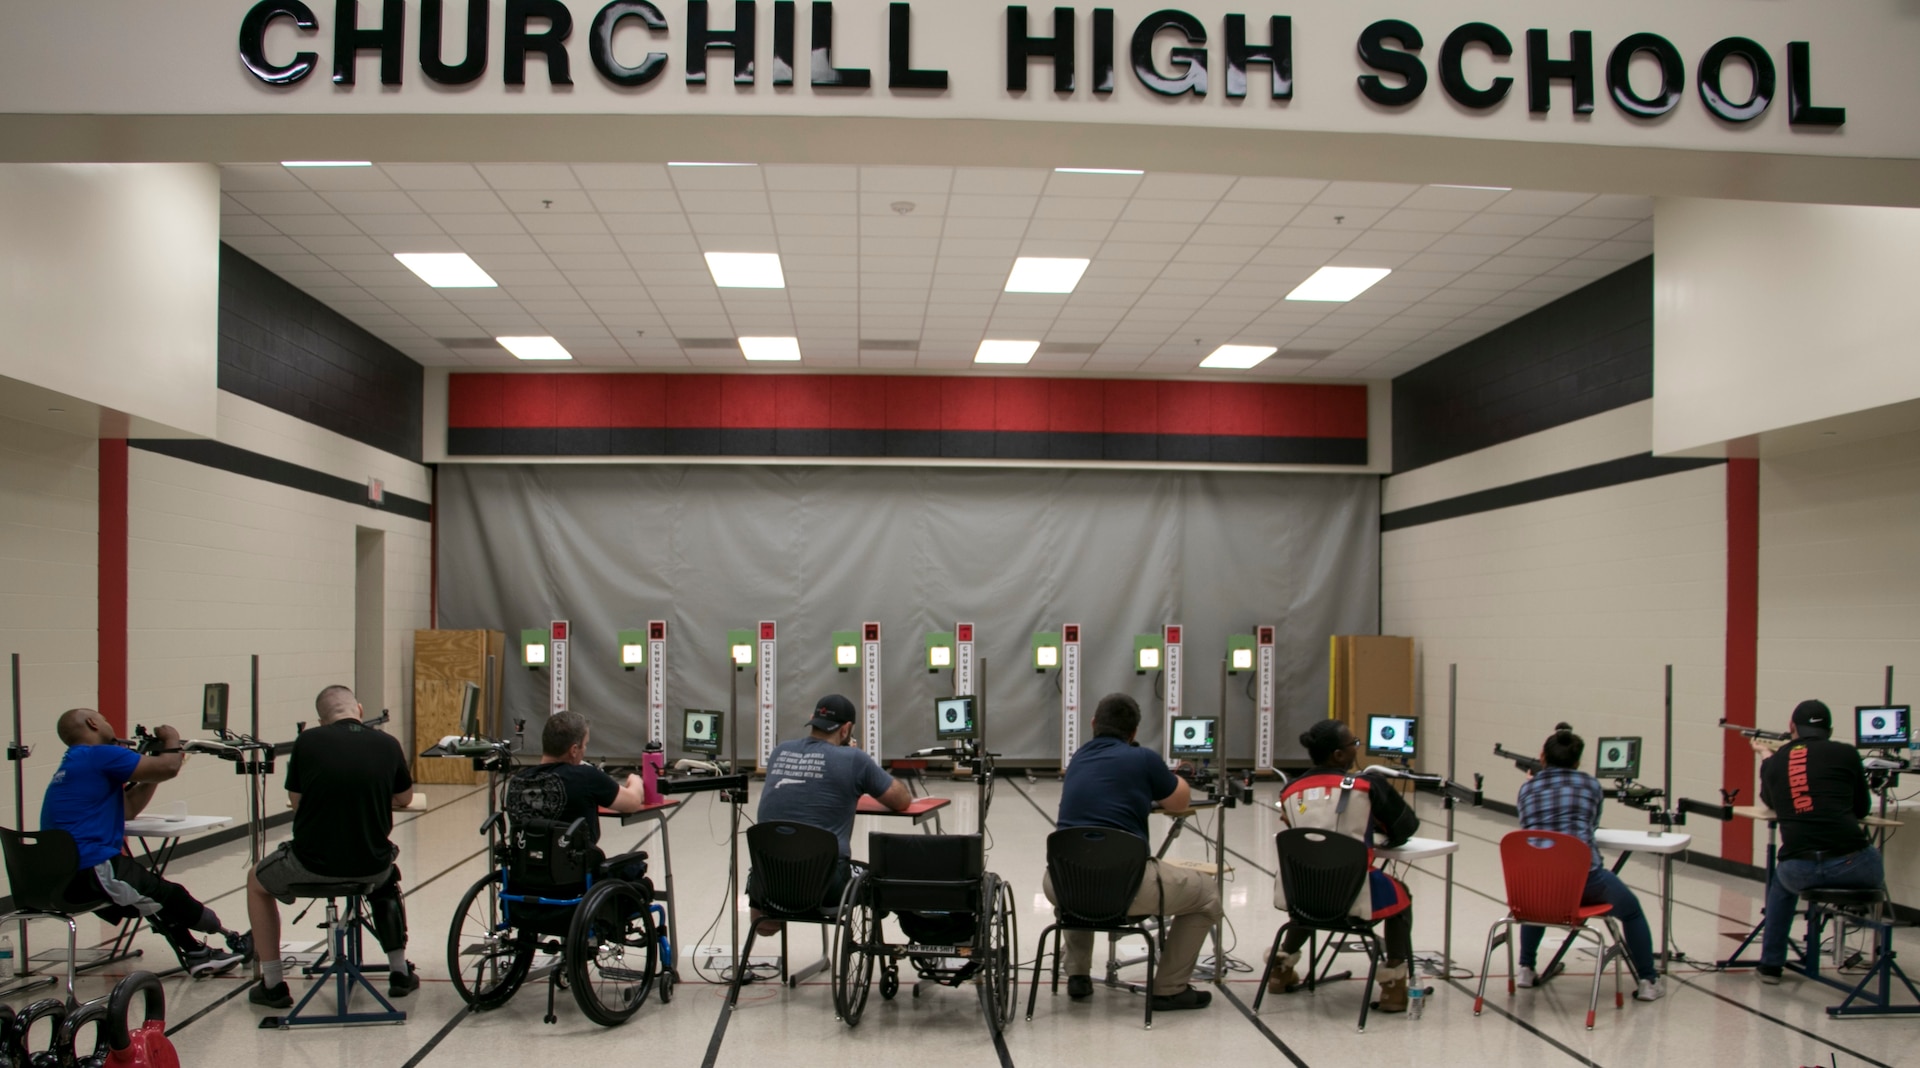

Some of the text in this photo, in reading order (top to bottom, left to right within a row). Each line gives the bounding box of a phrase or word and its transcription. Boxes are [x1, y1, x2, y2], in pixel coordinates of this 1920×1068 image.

[238, 0, 1846, 126] CHURCHILL HIGH SCHOOL
[1789, 748, 1812, 808] DIABLO
